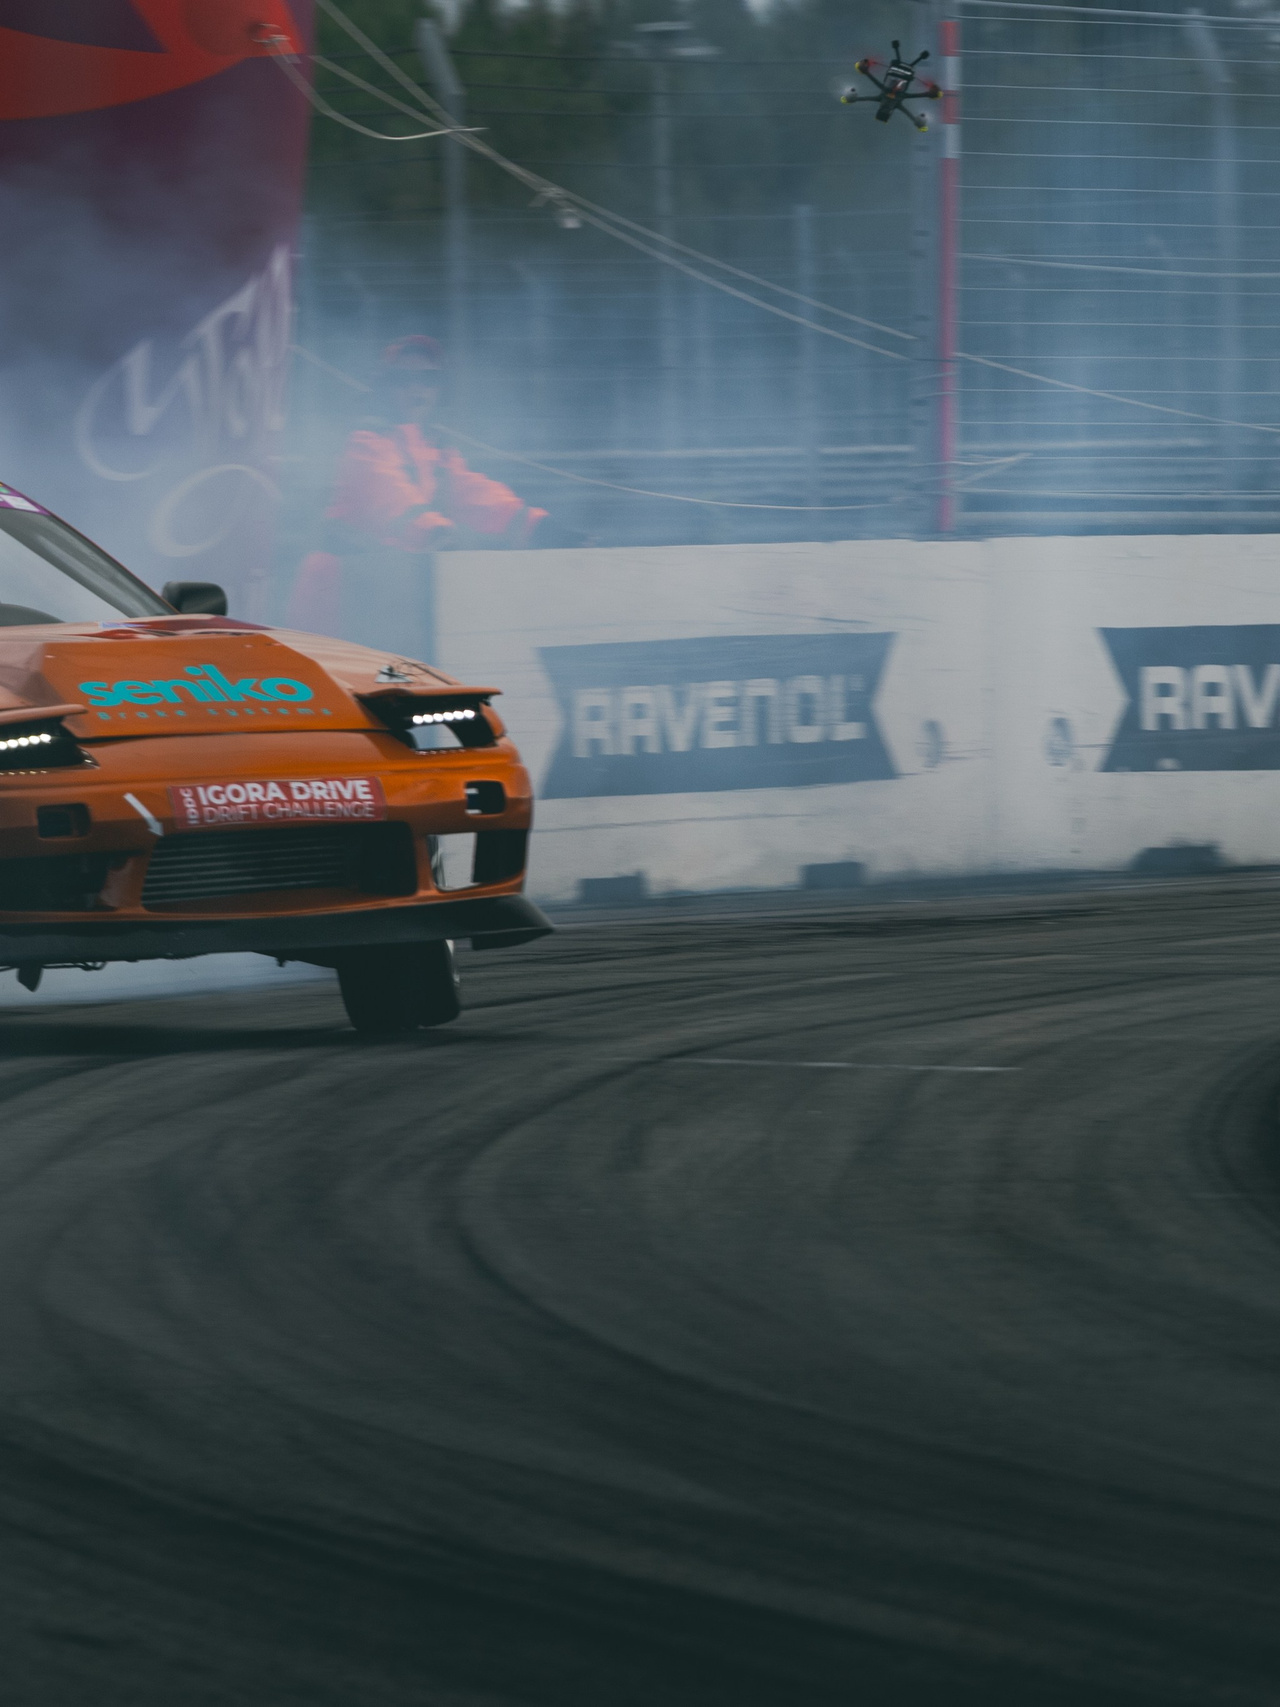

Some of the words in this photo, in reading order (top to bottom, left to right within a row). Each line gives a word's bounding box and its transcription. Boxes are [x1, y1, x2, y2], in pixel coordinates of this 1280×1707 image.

[78, 664, 314, 706] seniko
[1140, 664, 1280, 730] RAV
[97, 709, 187, 720] Brake
[180, 788, 199, 824] IDDC
[197, 782, 288, 806] IGORA
[289, 780, 374, 801] DRIVE
[203, 803, 259, 823] DRIFT
[262, 801, 376, 819] CHALLENGE
